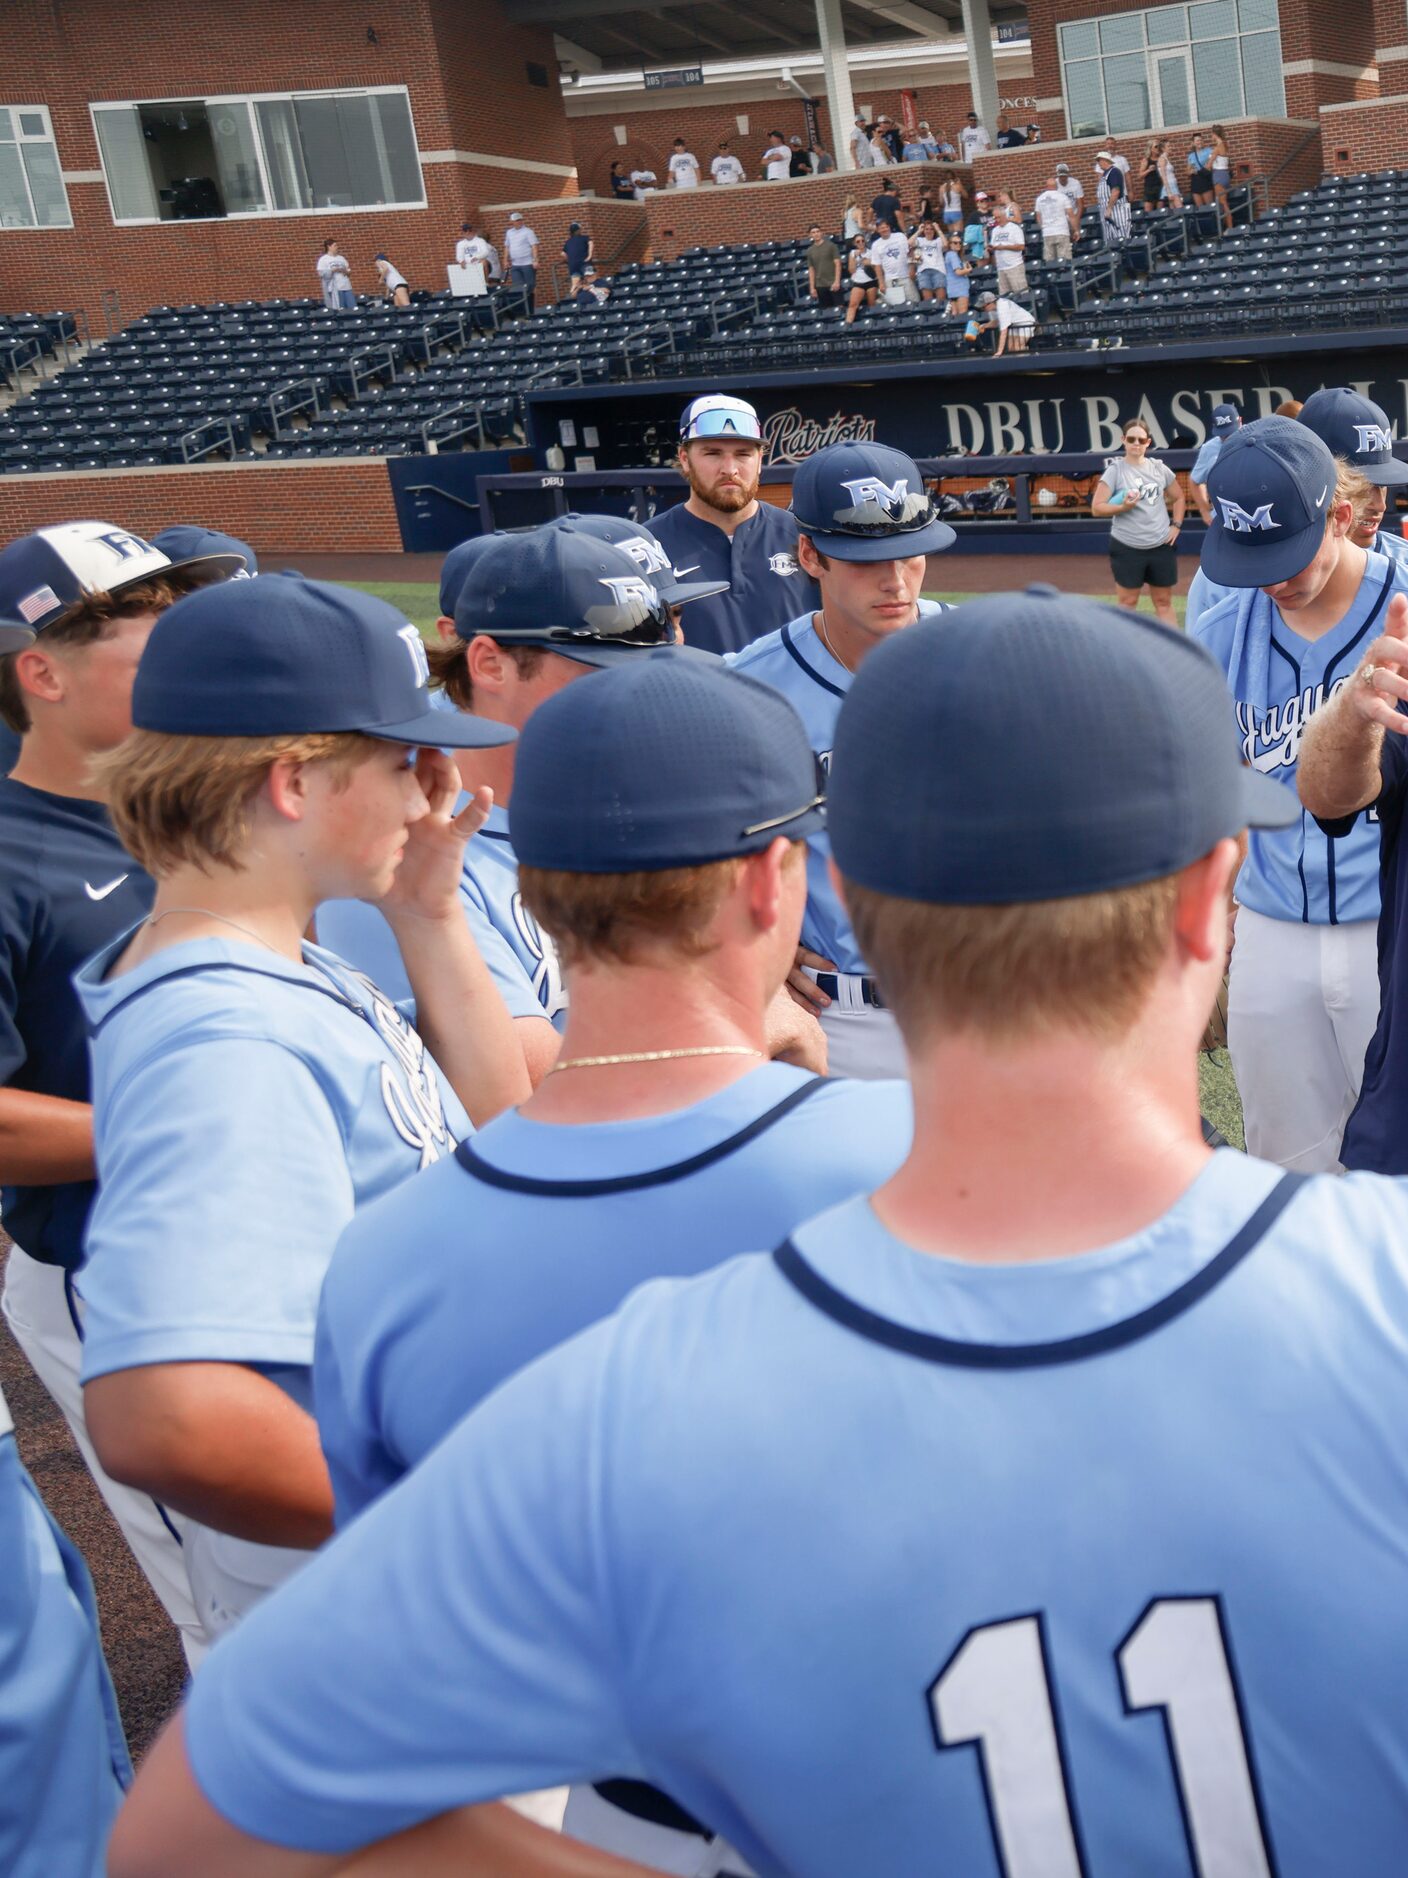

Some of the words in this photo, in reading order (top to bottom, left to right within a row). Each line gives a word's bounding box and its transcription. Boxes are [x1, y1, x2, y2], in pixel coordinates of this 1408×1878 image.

[764, 406, 876, 467] Patriots
[942, 398, 1066, 457] DBU
[1353, 424, 1393, 454] FM
[542, 476, 565, 488] DBU
[840, 476, 909, 511] FM
[1216, 496, 1283, 533] FM
[924, 1594, 1284, 1878] 11
